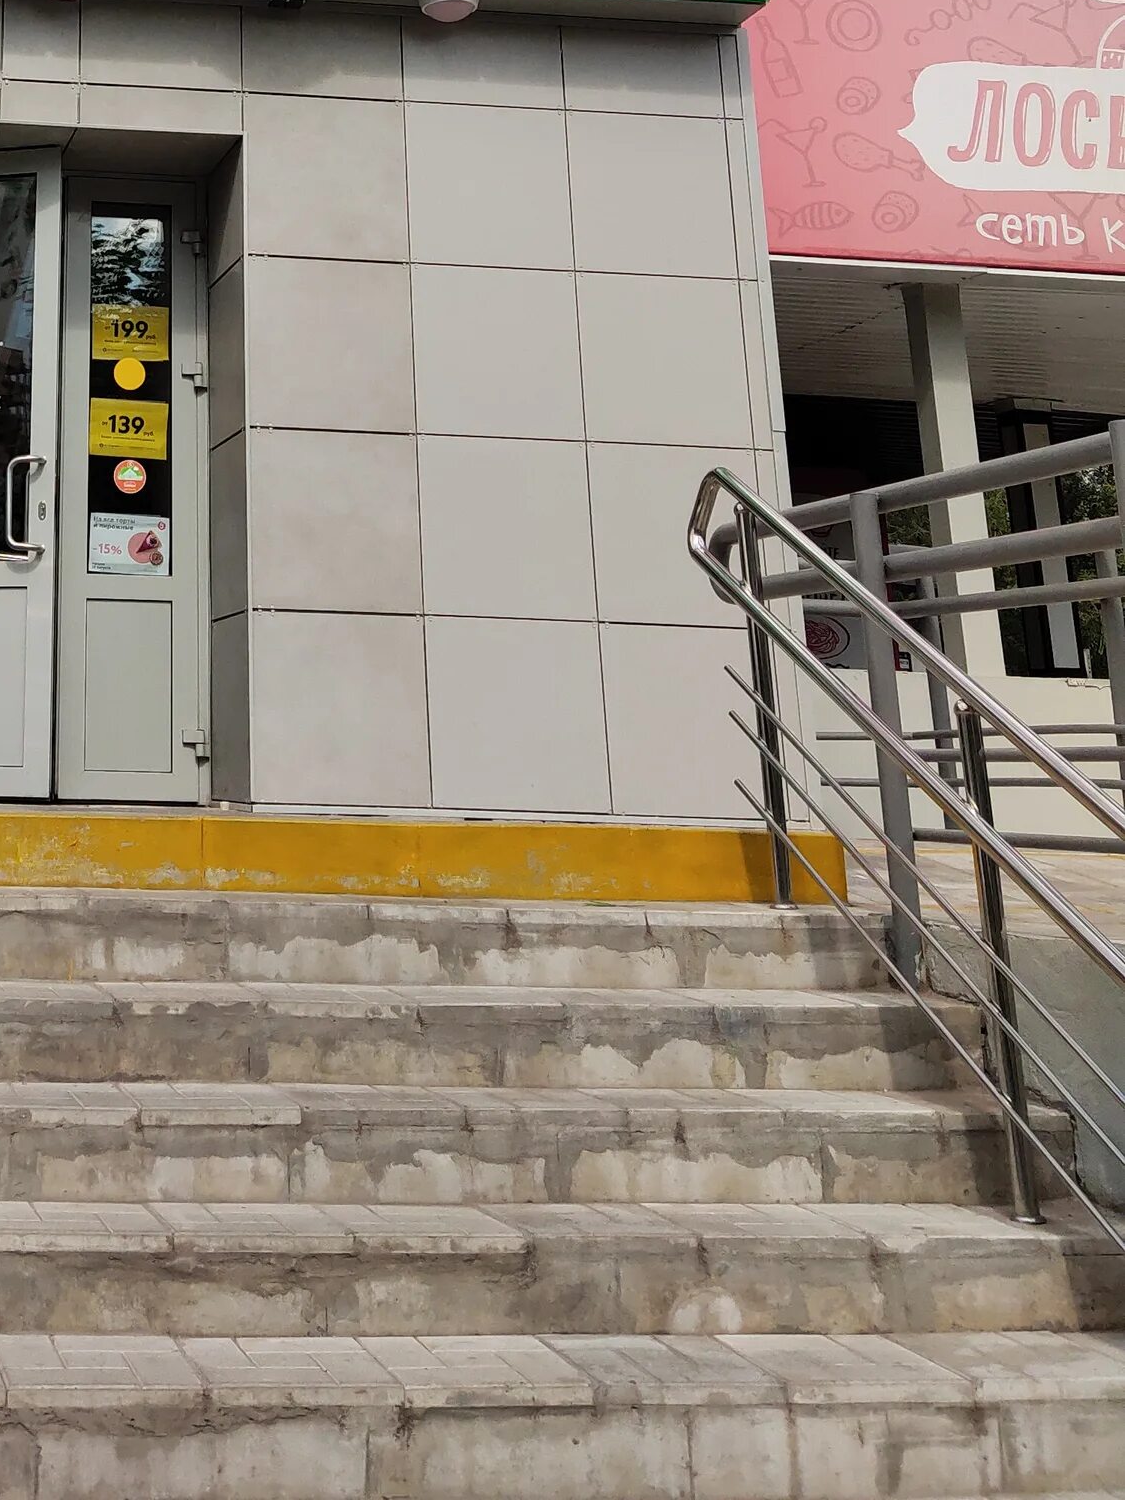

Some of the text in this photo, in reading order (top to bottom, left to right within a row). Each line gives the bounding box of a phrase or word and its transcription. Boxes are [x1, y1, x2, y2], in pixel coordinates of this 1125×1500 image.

[975, 212, 1086, 248] сеть
[110, 319, 149, 338] 199
[108, 414, 145, 435] 139
